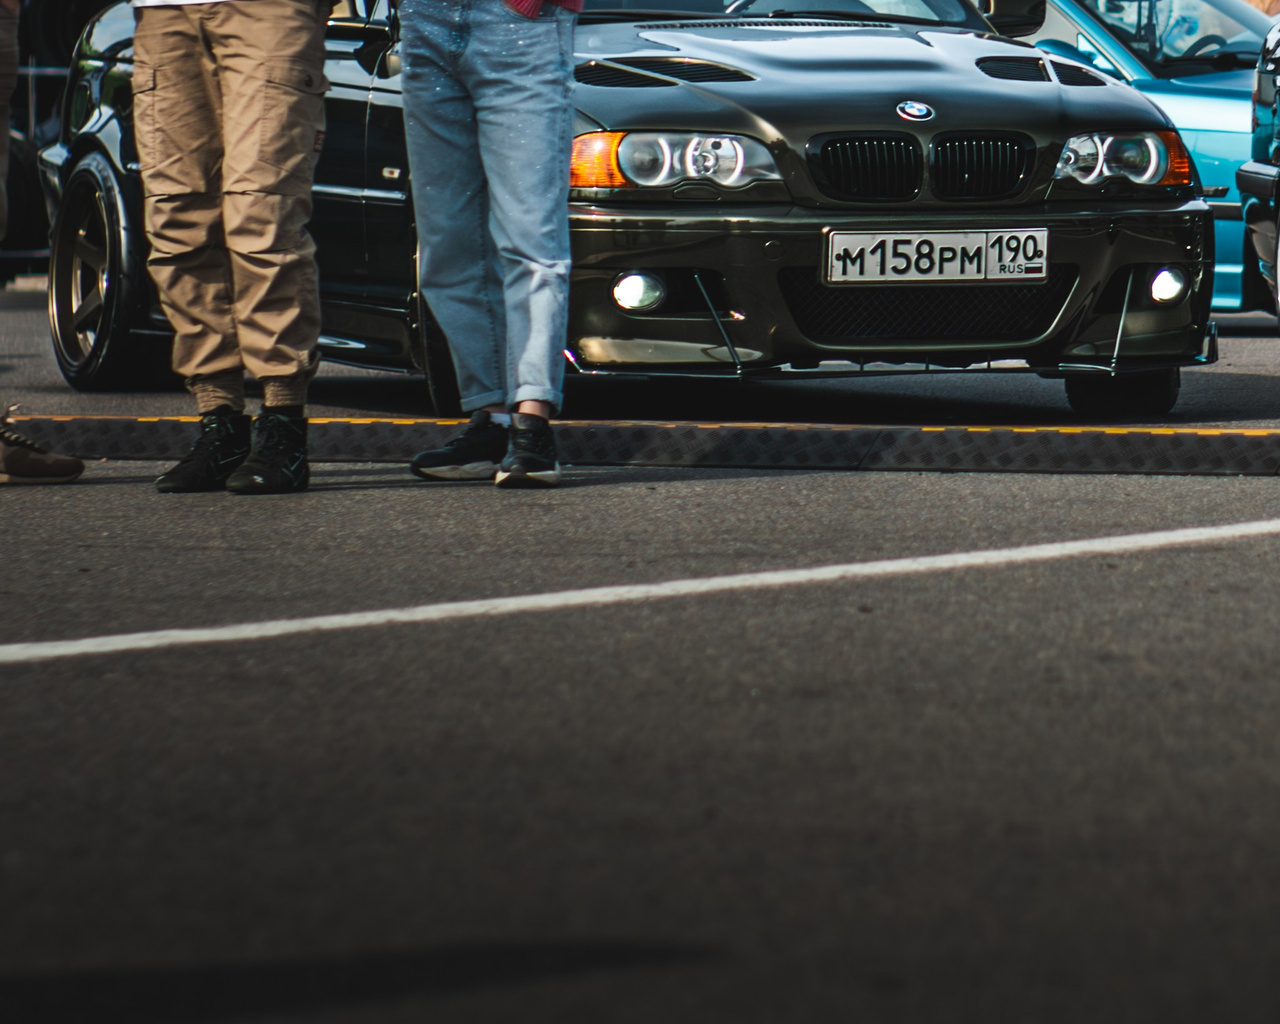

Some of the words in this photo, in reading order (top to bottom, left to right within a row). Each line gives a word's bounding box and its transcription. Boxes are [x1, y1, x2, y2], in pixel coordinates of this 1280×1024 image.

[841, 238, 983, 276] М158РМ
[989, 234, 1038, 263] 190
[999, 263, 1024, 274] RUS
